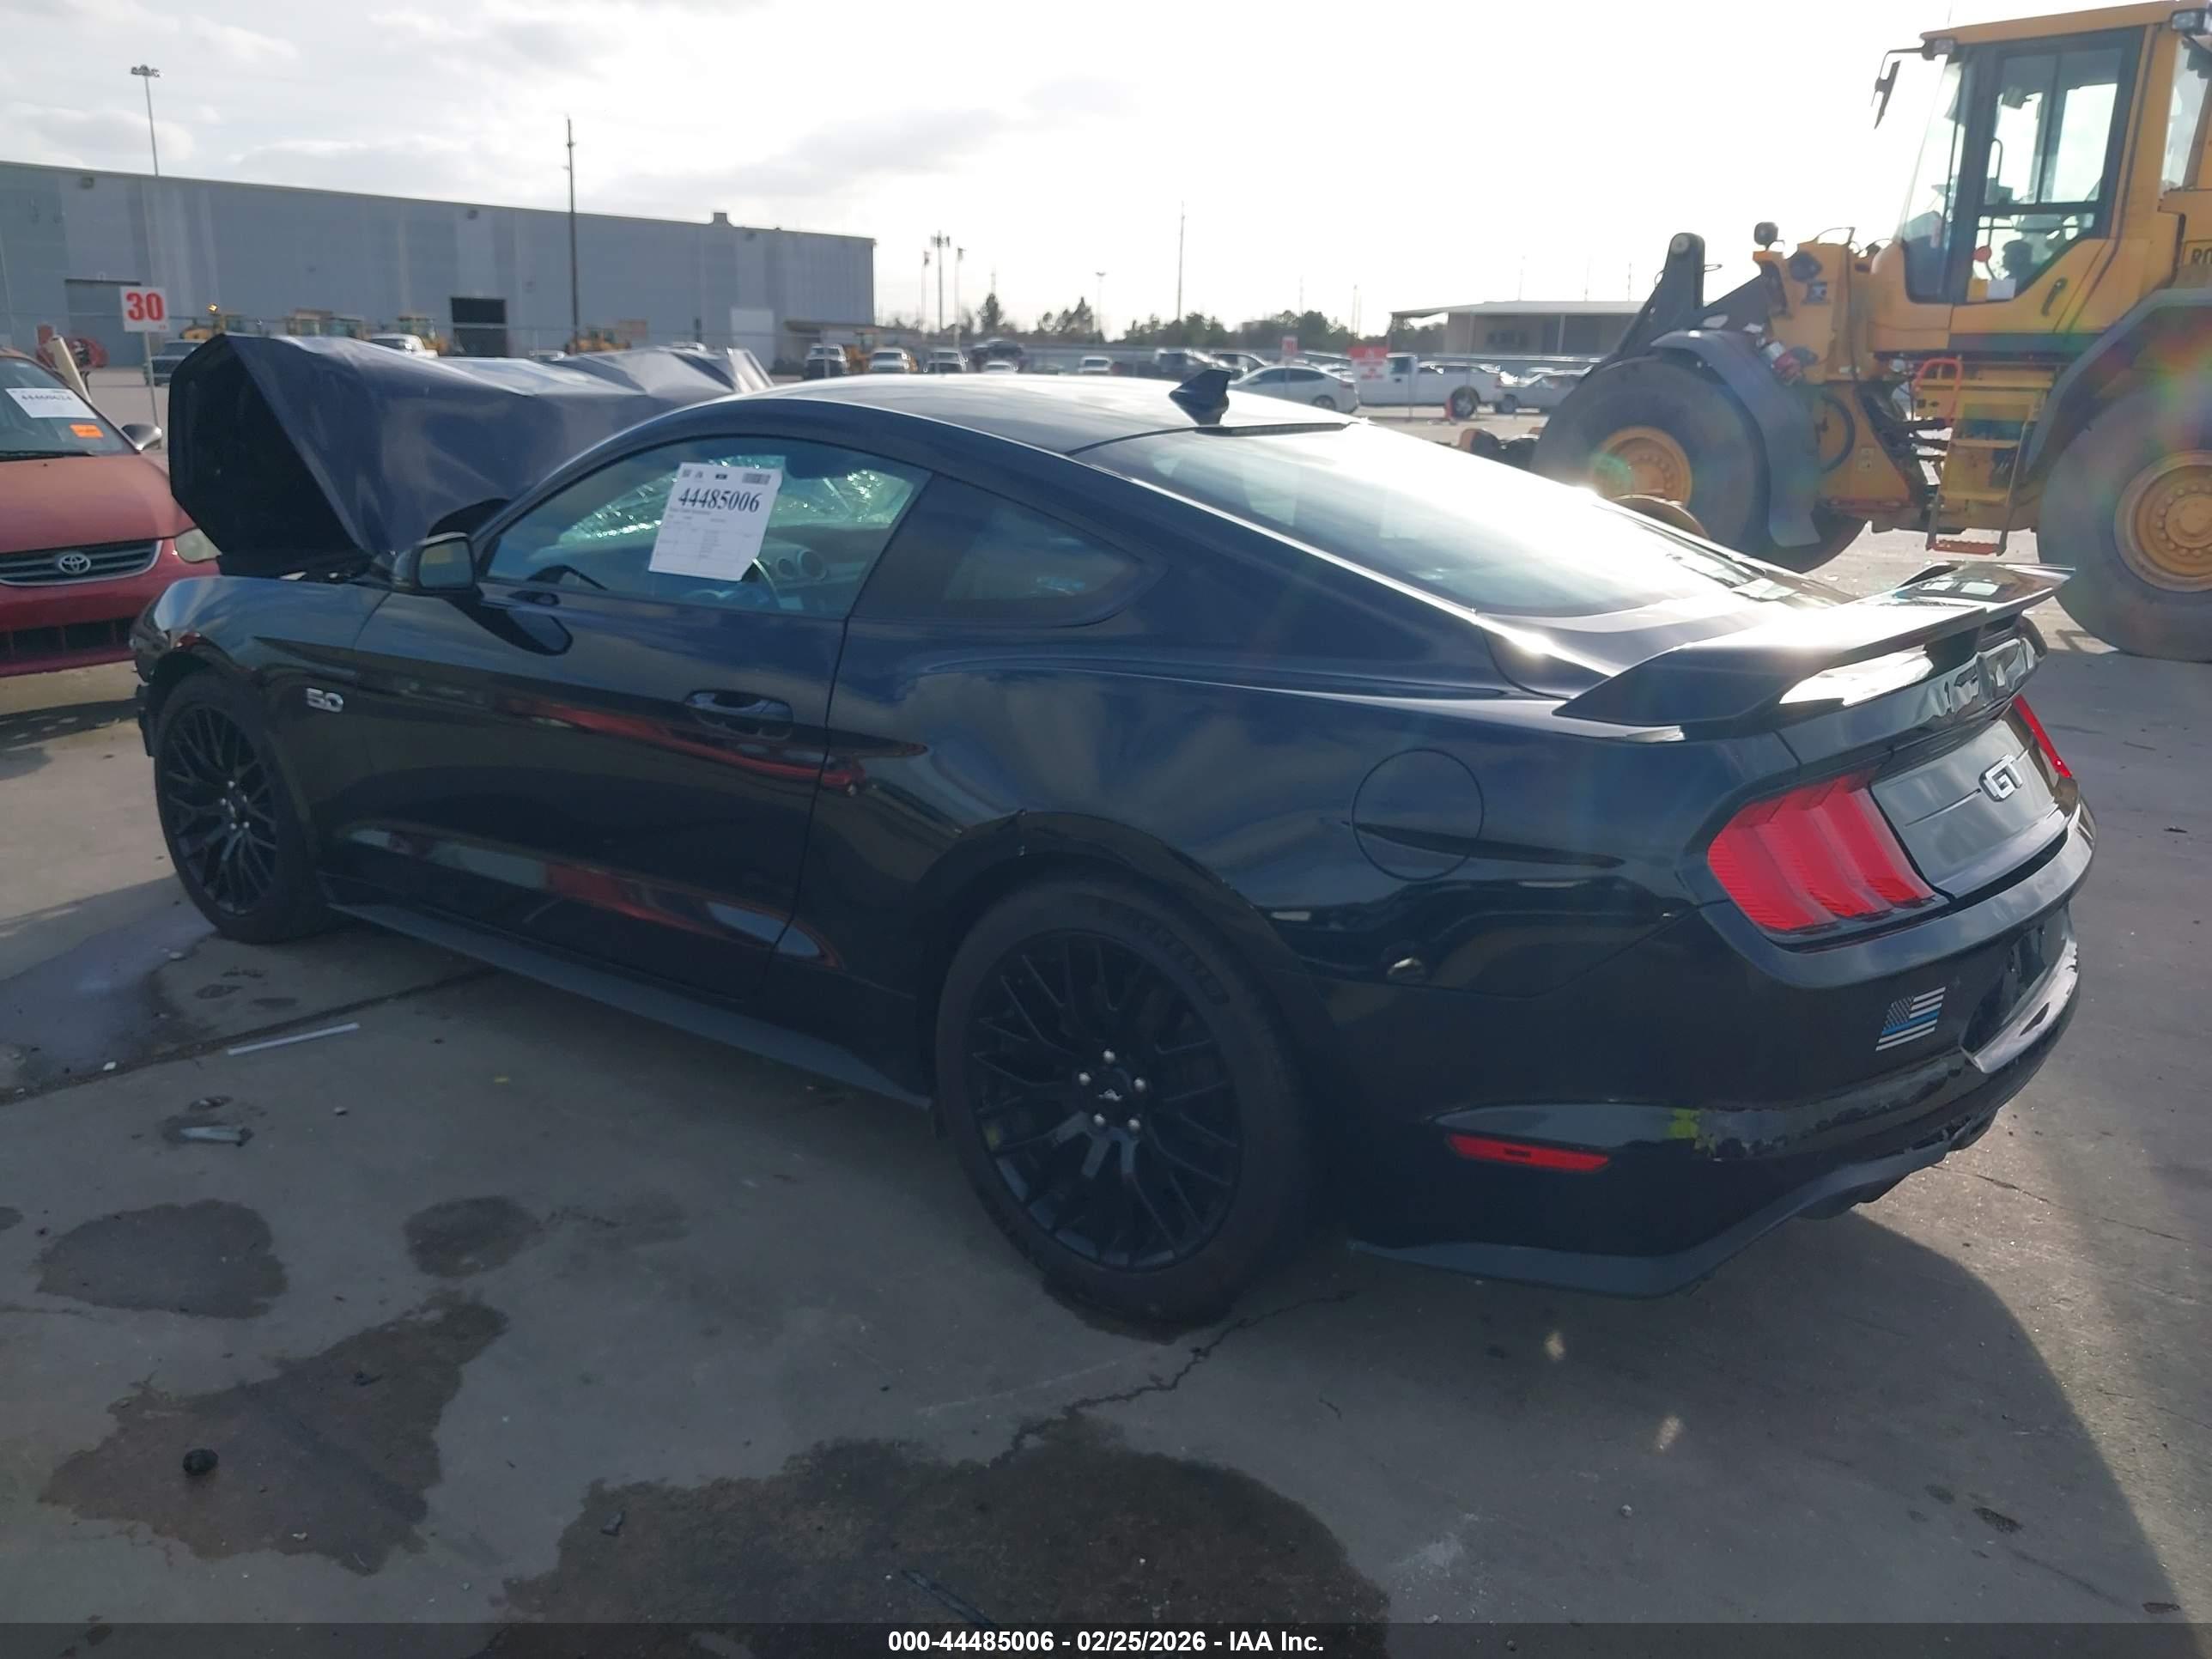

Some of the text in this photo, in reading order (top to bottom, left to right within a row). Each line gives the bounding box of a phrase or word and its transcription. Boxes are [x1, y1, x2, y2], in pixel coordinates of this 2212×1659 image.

[126, 292, 163, 320] 30
[678, 487, 763, 513] 44485006
[1980, 754, 2023, 800] GT
